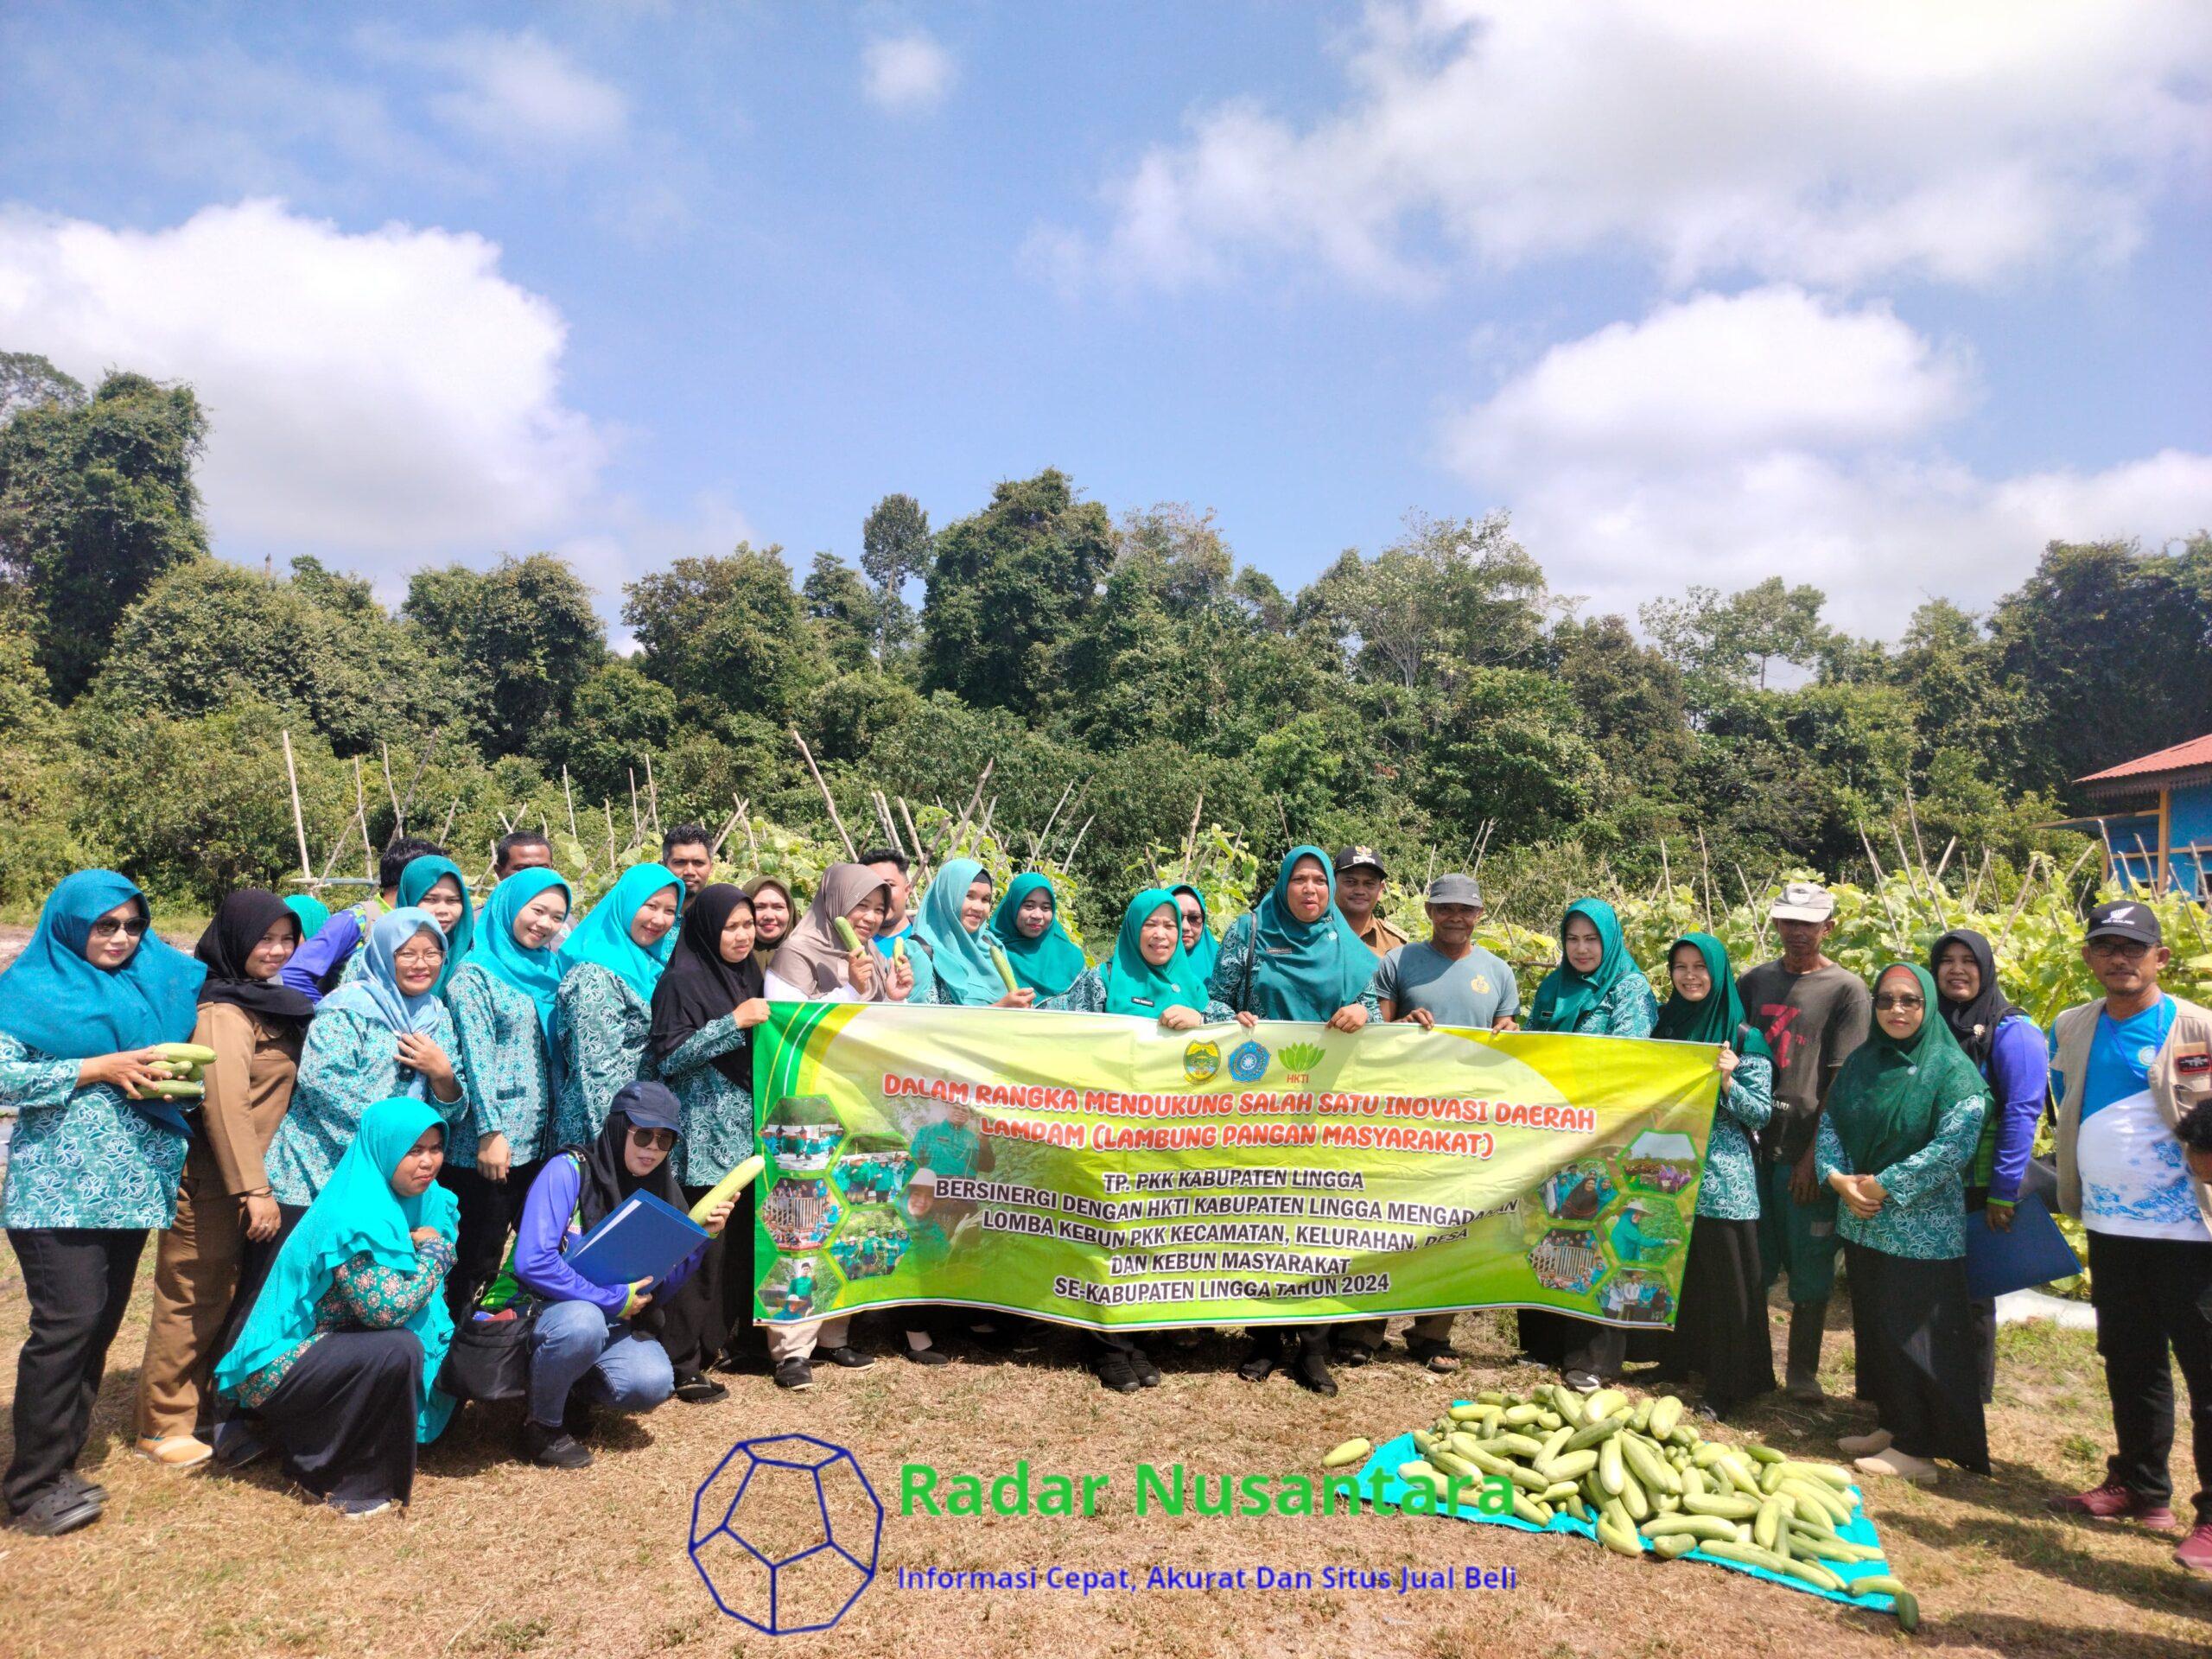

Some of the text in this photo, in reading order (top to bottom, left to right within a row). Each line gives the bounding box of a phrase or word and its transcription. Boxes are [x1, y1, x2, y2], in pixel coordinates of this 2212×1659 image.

[1287, 1073, 1309, 1084] HKTI
[884, 1073, 1597, 1132] DALAM RANGKA MENDUKUNG SALAH SATU INOVASI DAERAH
[1092, 1123, 1217, 1152] (LAMBUNG
[1222, 1123, 1317, 1147] PANGAN
[1321, 1124, 1495, 1159] MASYARAKAT)
[1103, 1168, 1364, 1193] TP. PKK KABUPATEN LINGGA
[934, 1179, 1058, 1209] BERSINERGI
[1061, 1193, 1143, 1223] DENGAN
[1146, 1197, 1191, 1217] HKTI
[1193, 1196, 1306, 1216] KABUPATEN
[1308, 1197, 1382, 1219] LINGGA
[982, 1210, 1468, 1252] LOMBA KEBUN PKK KECAMATAN, KELURAHAN, DESA
[1110, 1252, 1351, 1276] DAN KEBUN MASYARAKAT
[1054, 1273, 1390, 1306] SE-KABUPATEN LINGGA TAHUN 2024
